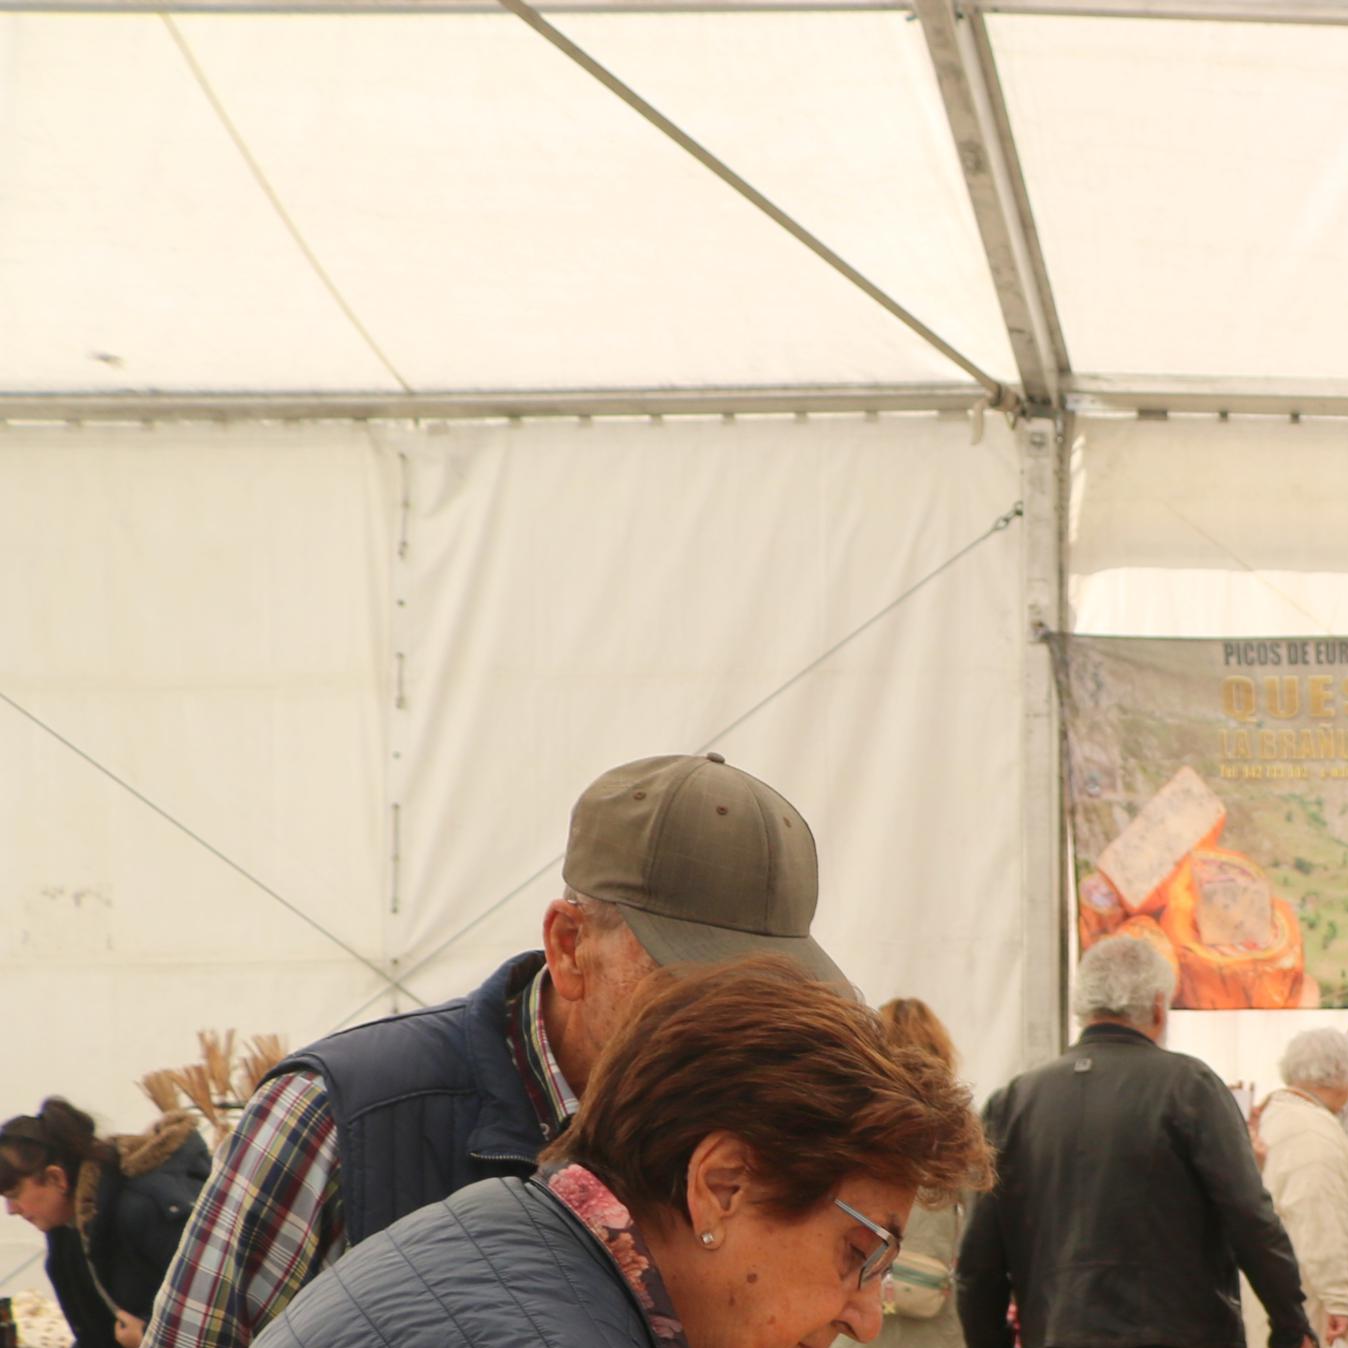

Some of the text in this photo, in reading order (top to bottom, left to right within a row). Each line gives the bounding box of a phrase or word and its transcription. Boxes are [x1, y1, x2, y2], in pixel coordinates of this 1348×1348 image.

[1223, 642, 1281, 666] PICOS
[1287, 641, 1310, 665] DE
[1219, 728, 1251, 760] LA
